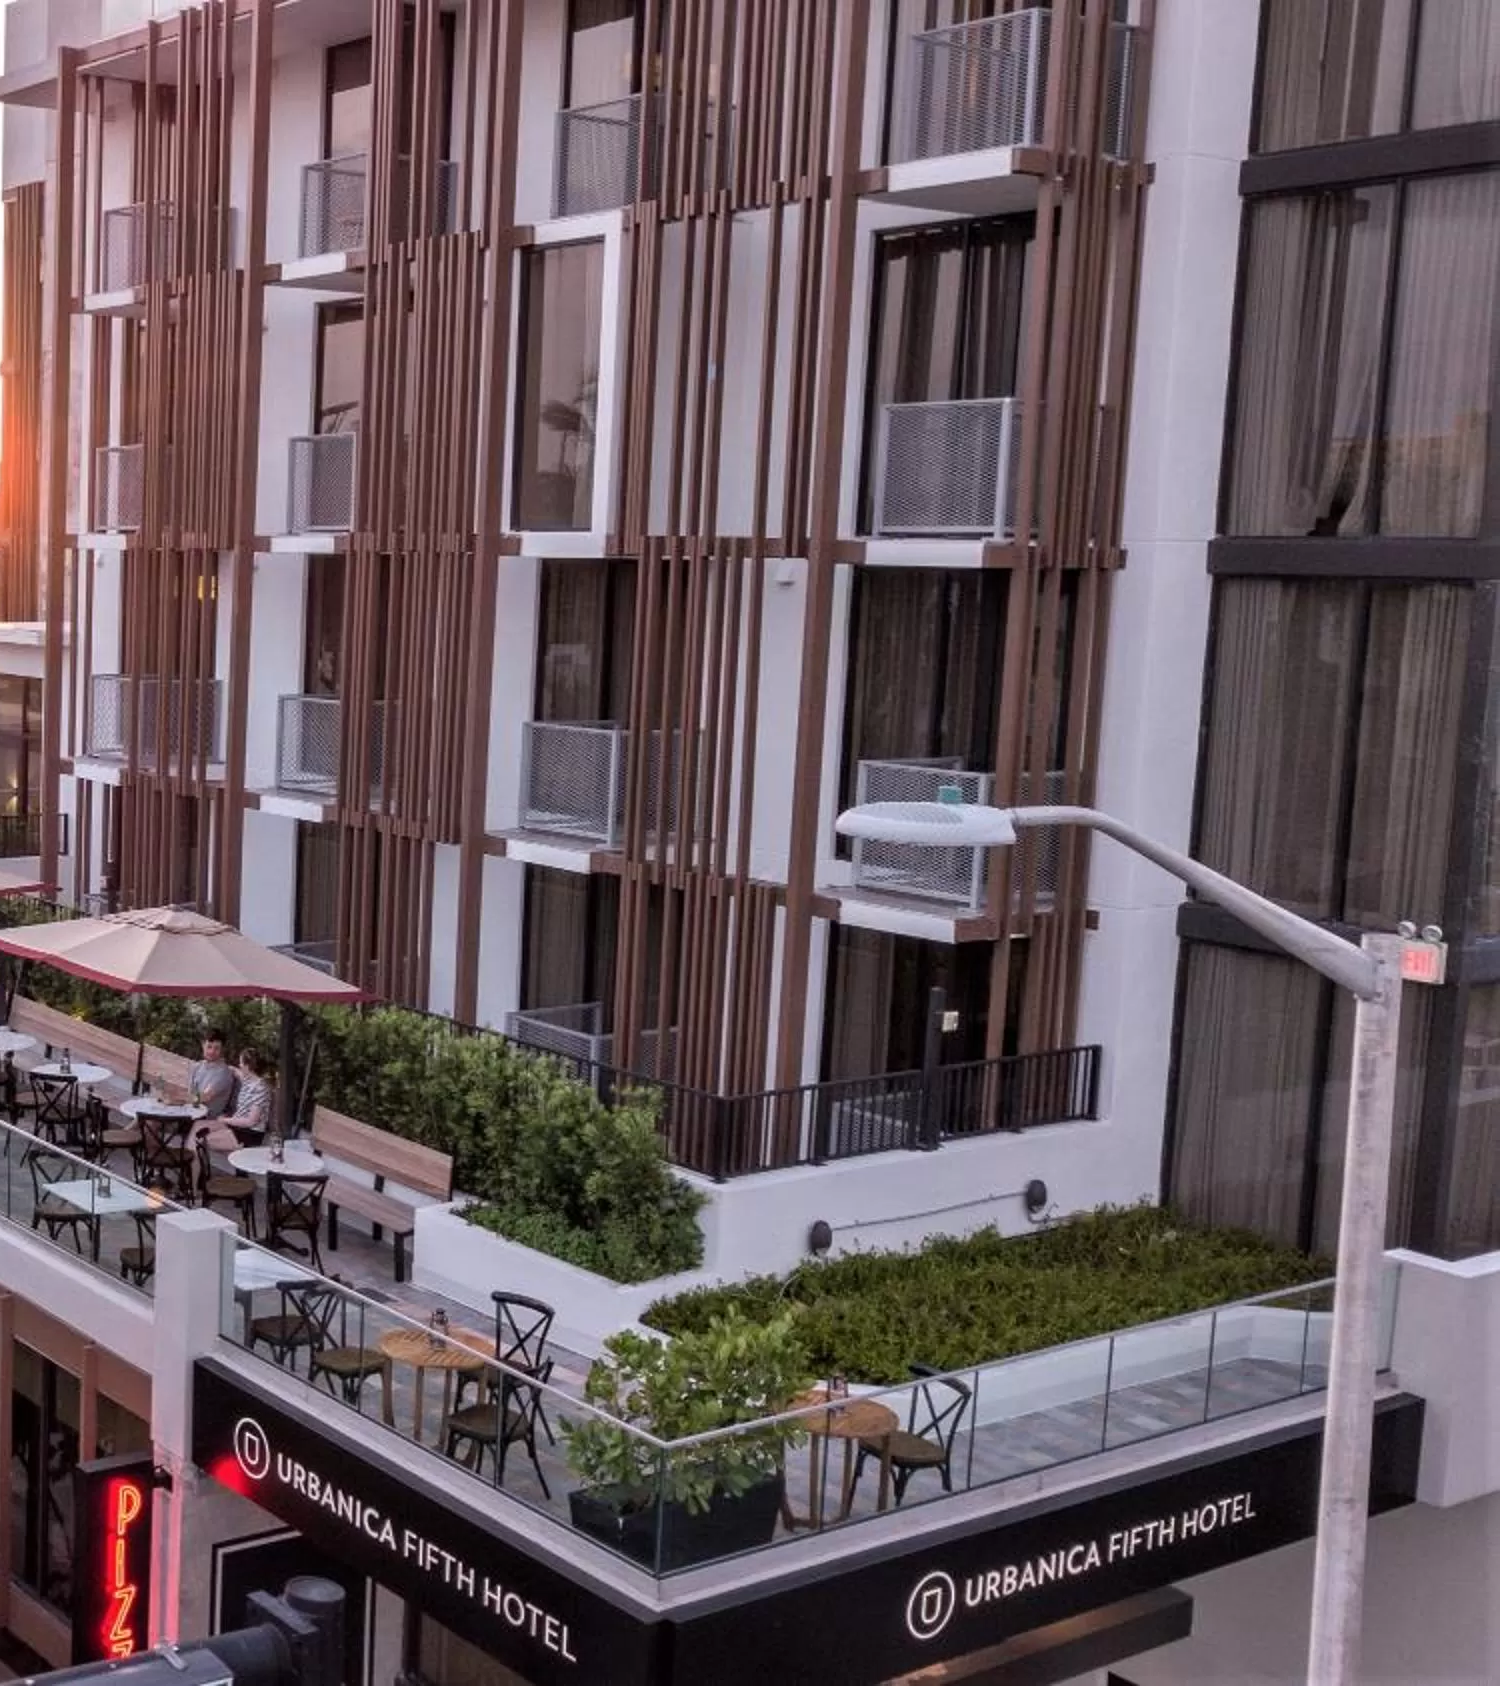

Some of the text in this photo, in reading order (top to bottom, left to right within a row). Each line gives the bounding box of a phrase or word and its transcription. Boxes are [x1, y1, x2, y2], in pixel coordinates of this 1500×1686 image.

[277, 1453, 577, 1664] URBANICA FIFTH HOTEL
[966, 1492, 1256, 1606] URBANICA FIFTH HOTEL
